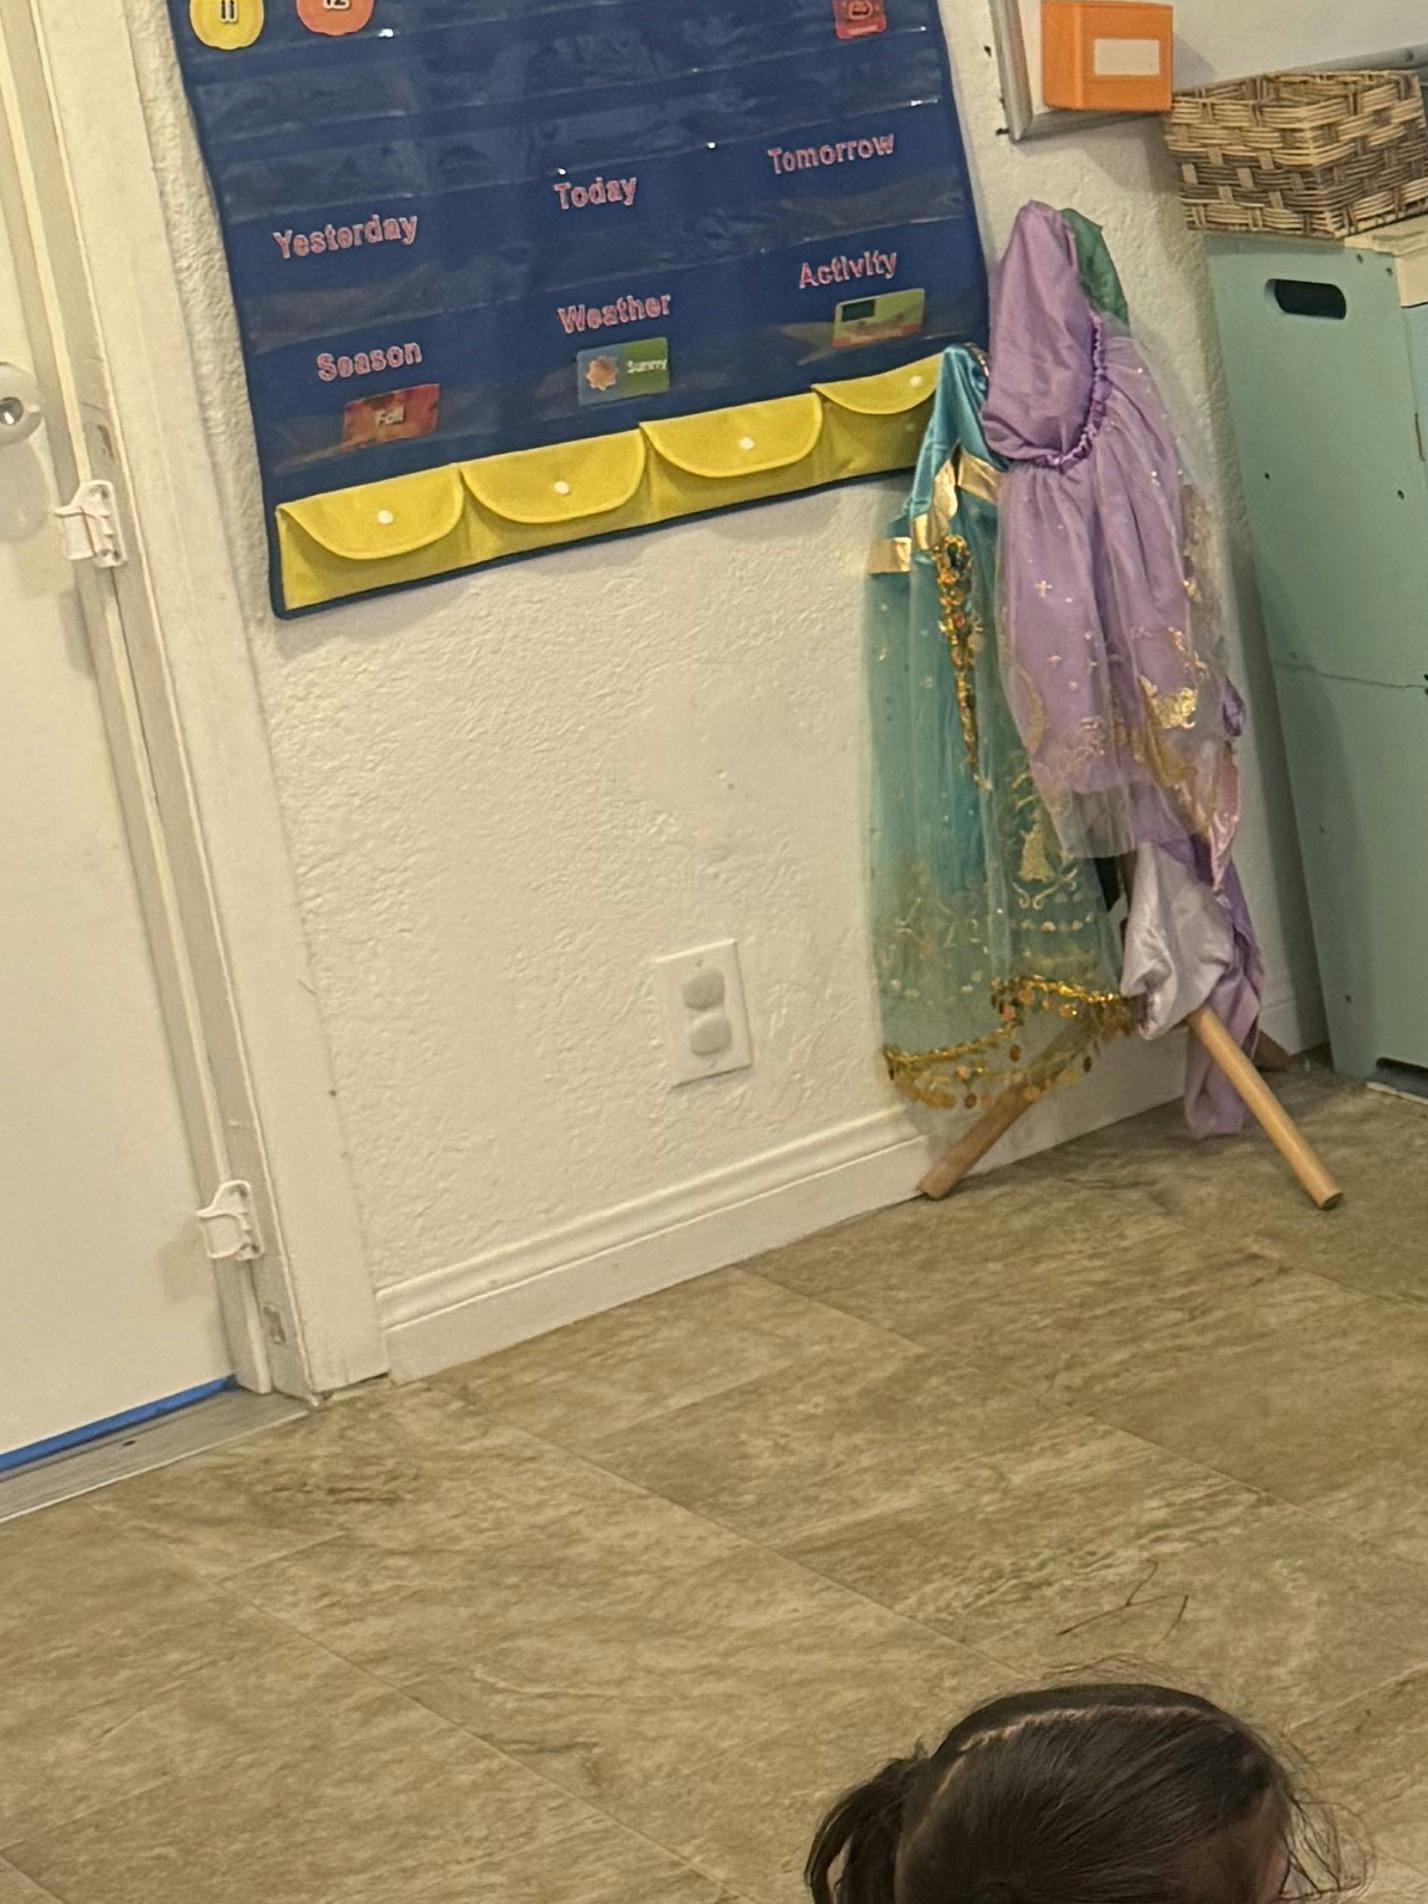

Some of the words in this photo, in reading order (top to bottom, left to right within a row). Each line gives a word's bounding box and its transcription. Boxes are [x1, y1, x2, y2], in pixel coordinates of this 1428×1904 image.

[767, 133, 895, 175] Tomorrow
[553, 174, 637, 210] Today
[273, 212, 418, 261] Yesterday
[799, 249, 897, 290] Activity
[557, 294, 671, 334] Weather
[317, 342, 422, 381] Season
[627, 358, 668, 374] Sunny
[376, 405, 404, 425] Fall
